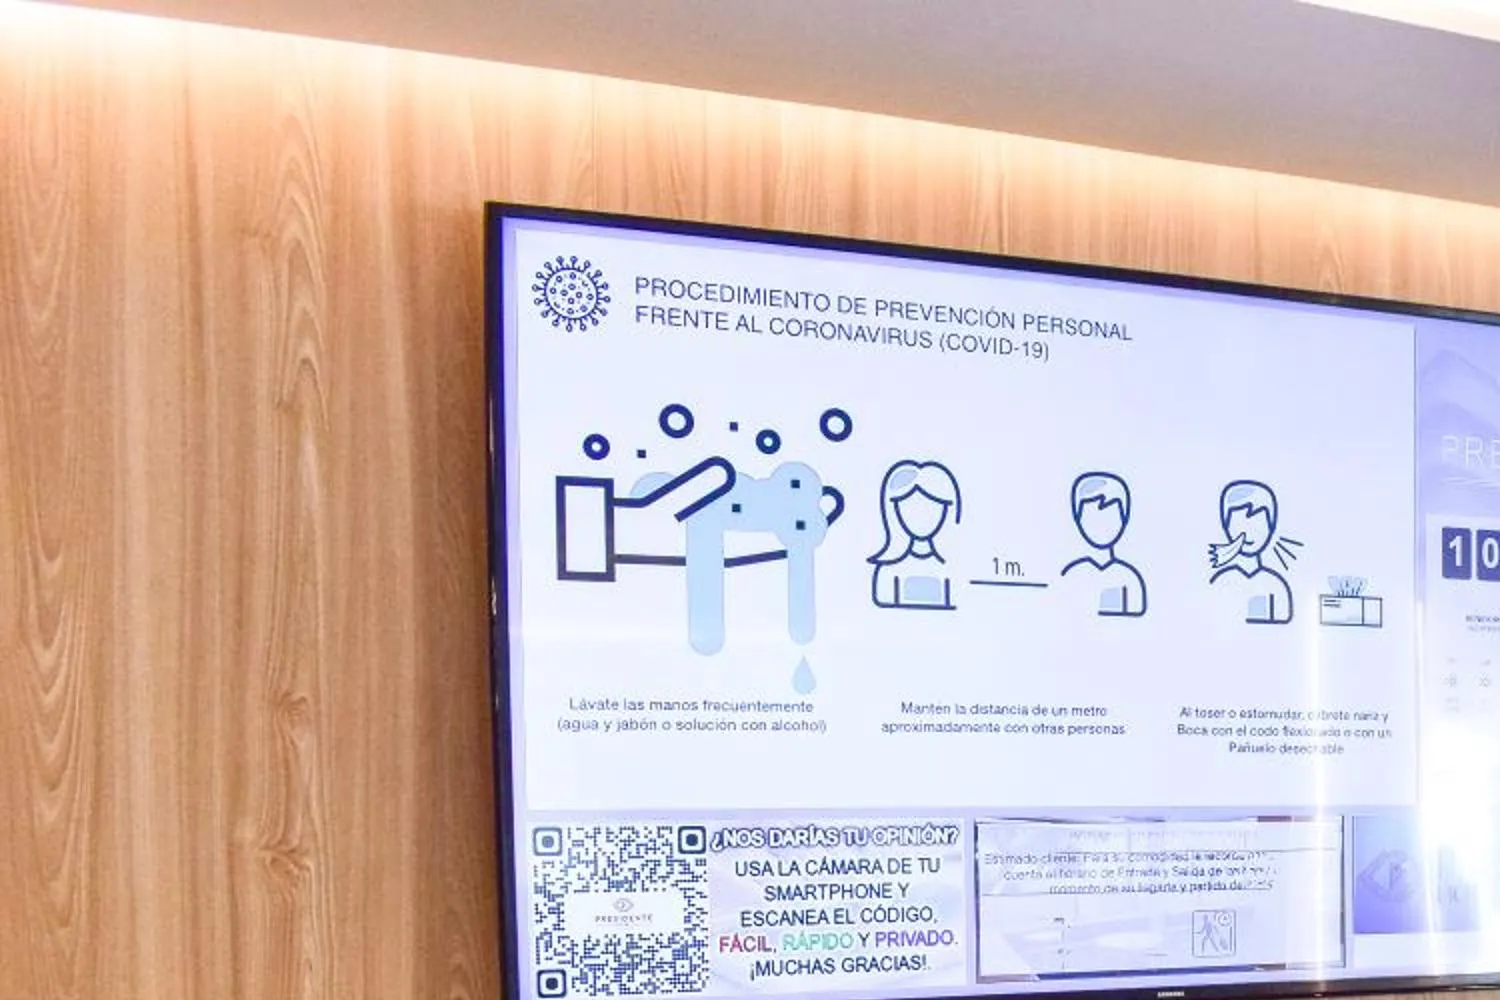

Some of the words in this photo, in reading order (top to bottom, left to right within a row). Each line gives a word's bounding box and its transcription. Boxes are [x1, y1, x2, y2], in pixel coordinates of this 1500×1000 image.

[635, 276, 830, 312] PROCEDIMIENTO
[837, 295, 867, 315] DE
[875, 298, 1015, 330] PREVENCIÓN
[1023, 313, 1133, 341] PERSONAL
[635, 306, 730, 331] FRENTE
[735, 315, 762, 333] AL
[769, 317, 933, 349] CORONAVIRUS
[939, 332, 1050, 362] (COVID-19)
[992, 556, 999, 575] 1
[1005, 561, 1025, 577] m.
[568, 698, 619, 711] Lávate
[624, 699, 644, 711] las
[649, 701, 698, 711] manos
[703, 700, 815, 713] frecuentemente
[955, 703, 967, 715] la
[969, 703, 1029, 716] distancia
[1031, 704, 1047, 716] de
[1052, 706, 1068, 716] un
[1072, 705, 1108, 716] metro
[1179, 706, 1192, 718] Al
[1195, 707, 1225, 718] toser
[1228, 709, 1237, 718] o
[1382, 712, 1389, 723] y
[557, 718, 598, 733] (agua
[603, 720, 611, 732] y
[616, 717, 657, 732] jabón
[662, 721, 671, 730] o
[676, 717, 736, 731] solución
[741, 721, 766, 731] con
[771, 718, 827, 732] alcohol)
[881, 721, 1000, 734] aproximadamente
[1004, 723, 1028, 733] con
[1031, 723, 1065, 734] otras
[1068, 724, 1126, 736] personas
[1177, 723, 1208, 736] Boca
[1211, 725, 1232, 736] con
[1236, 724, 1247, 736] el
[1250, 725, 1280, 737] codo
[1354, 728, 1375, 738] con
[710, 827, 765, 853] ¿NOS
[768, 824, 840, 849] DARÍAS
[844, 827, 869, 846] TU
[872, 823, 959, 847] OPINIÓN?
[735, 860, 774, 877] USA
[778, 859, 801, 876] LA
[805, 856, 882, 876] CÁMARA
[887, 858, 912, 875] DE
[917, 857, 941, 873] TU
[764, 882, 893, 901] SMARTPHONE
[898, 882, 910, 898] Y
[740, 909, 829, 927] ESCANEA
[834, 908, 855, 925] EL
[860, 904, 938, 924] CÓDIGO,
[719, 933, 777, 953] FÁCIL,
[782, 931, 854, 950] RÁPIDO
[858, 932, 870, 948] Y
[875, 930, 958, 948] PRIVADO.
[750, 958, 835, 981] ¡MUCHAS
